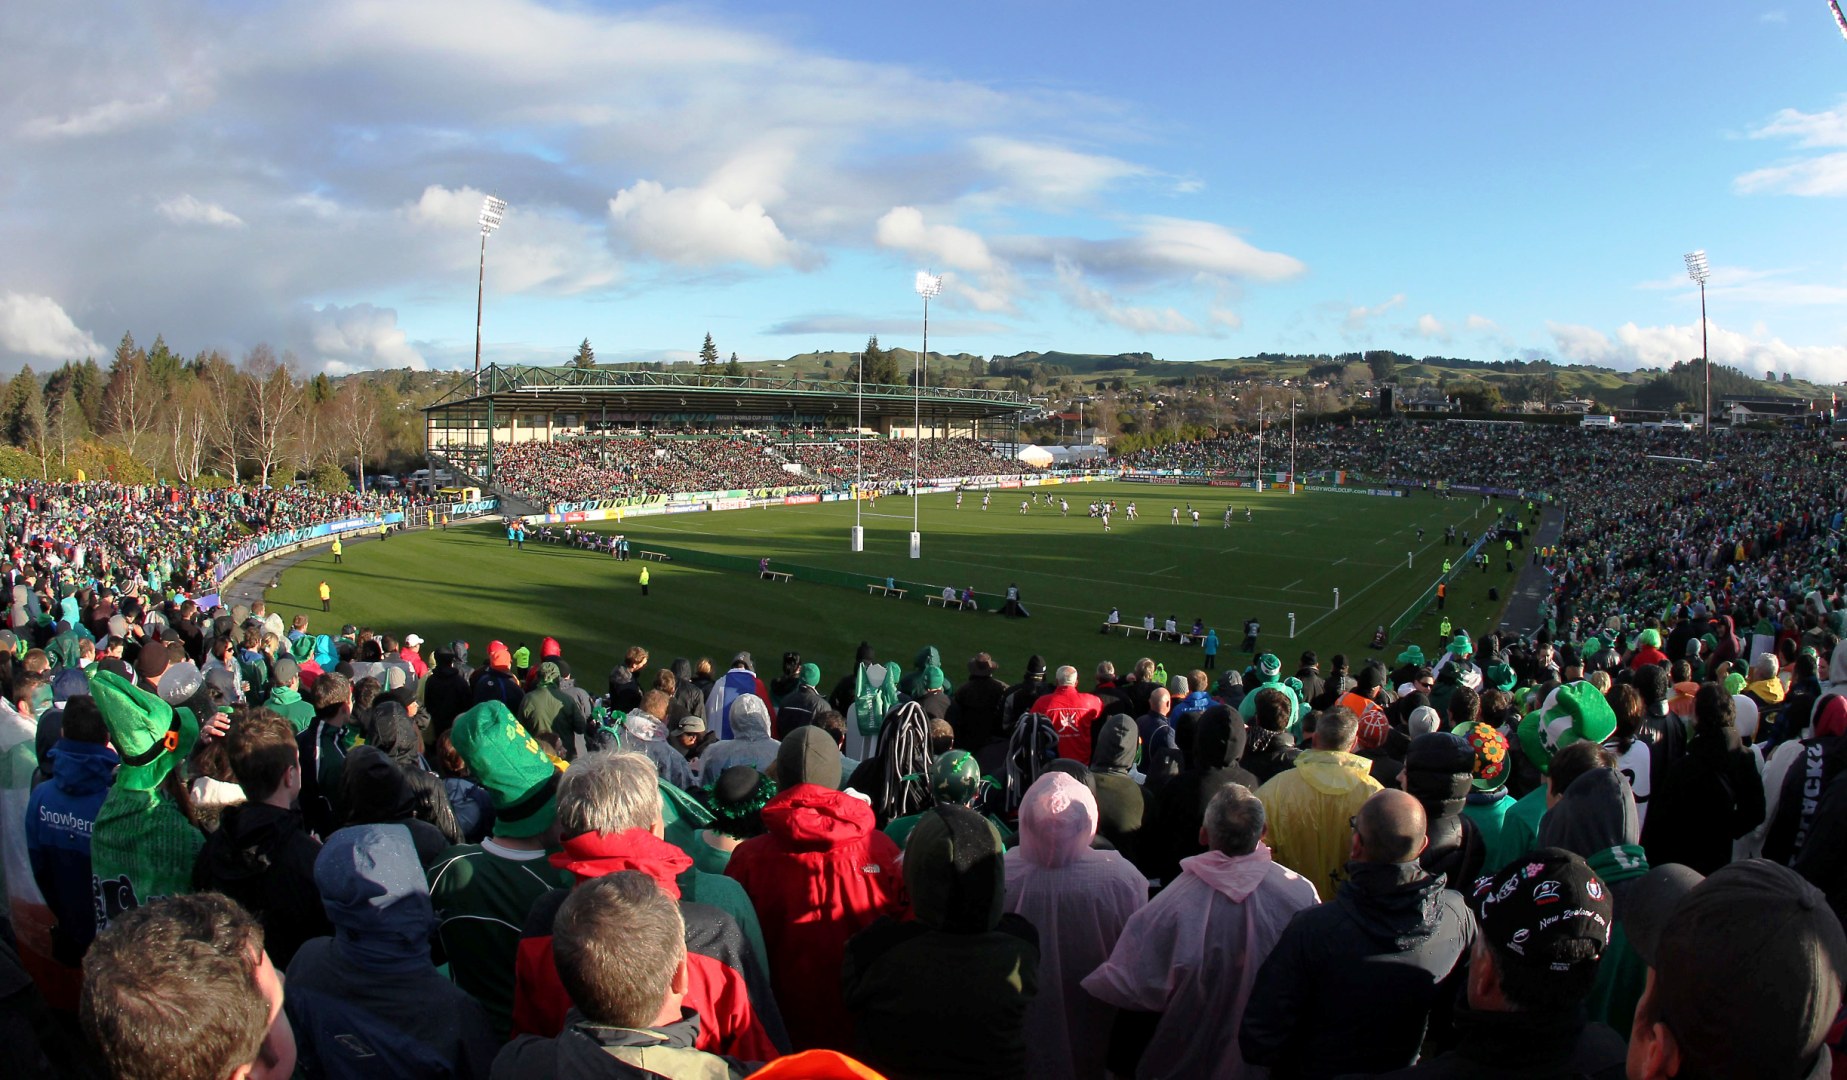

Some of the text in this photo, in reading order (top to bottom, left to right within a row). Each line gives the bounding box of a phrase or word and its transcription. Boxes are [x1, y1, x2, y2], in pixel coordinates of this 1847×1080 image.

[1304, 485, 1367, 495] RUGBYWORLDCUP.com
[788, 496, 796, 504] Fly
[797, 494, 817, 503] Emirates
[716, 500, 747, 510] TOSHIBA
[40, 805, 95, 833] Snowberr
[1540, 914, 1559, 930] New
[1562, 907, 1595, 920] Zealand
